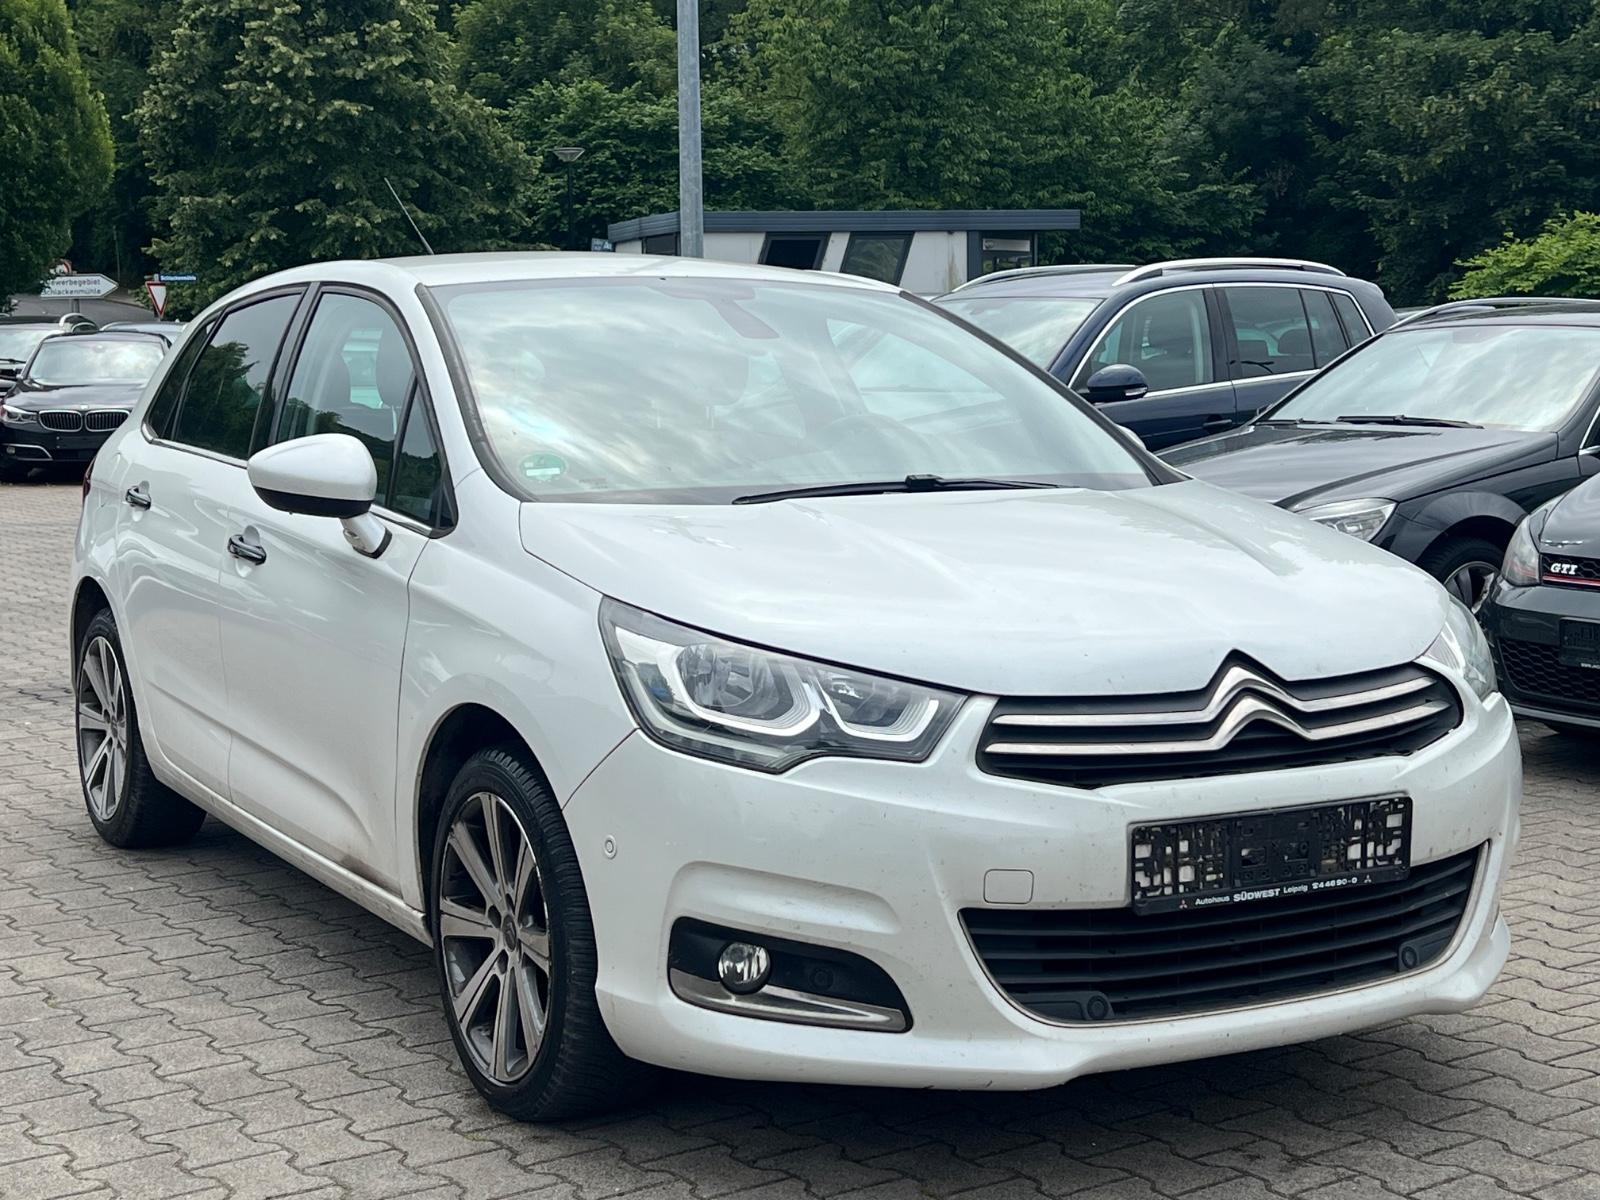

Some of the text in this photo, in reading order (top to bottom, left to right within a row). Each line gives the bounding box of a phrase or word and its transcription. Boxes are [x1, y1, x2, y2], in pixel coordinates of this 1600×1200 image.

[48, 279, 101, 287] ewerbegebiet
[1550, 562, 1578, 575] GTI
[1195, 895, 1230, 905] Autohaus
[1233, 888, 1281, 902] SÜDWEST
[1283, 884, 1308, 894] Leipzig
